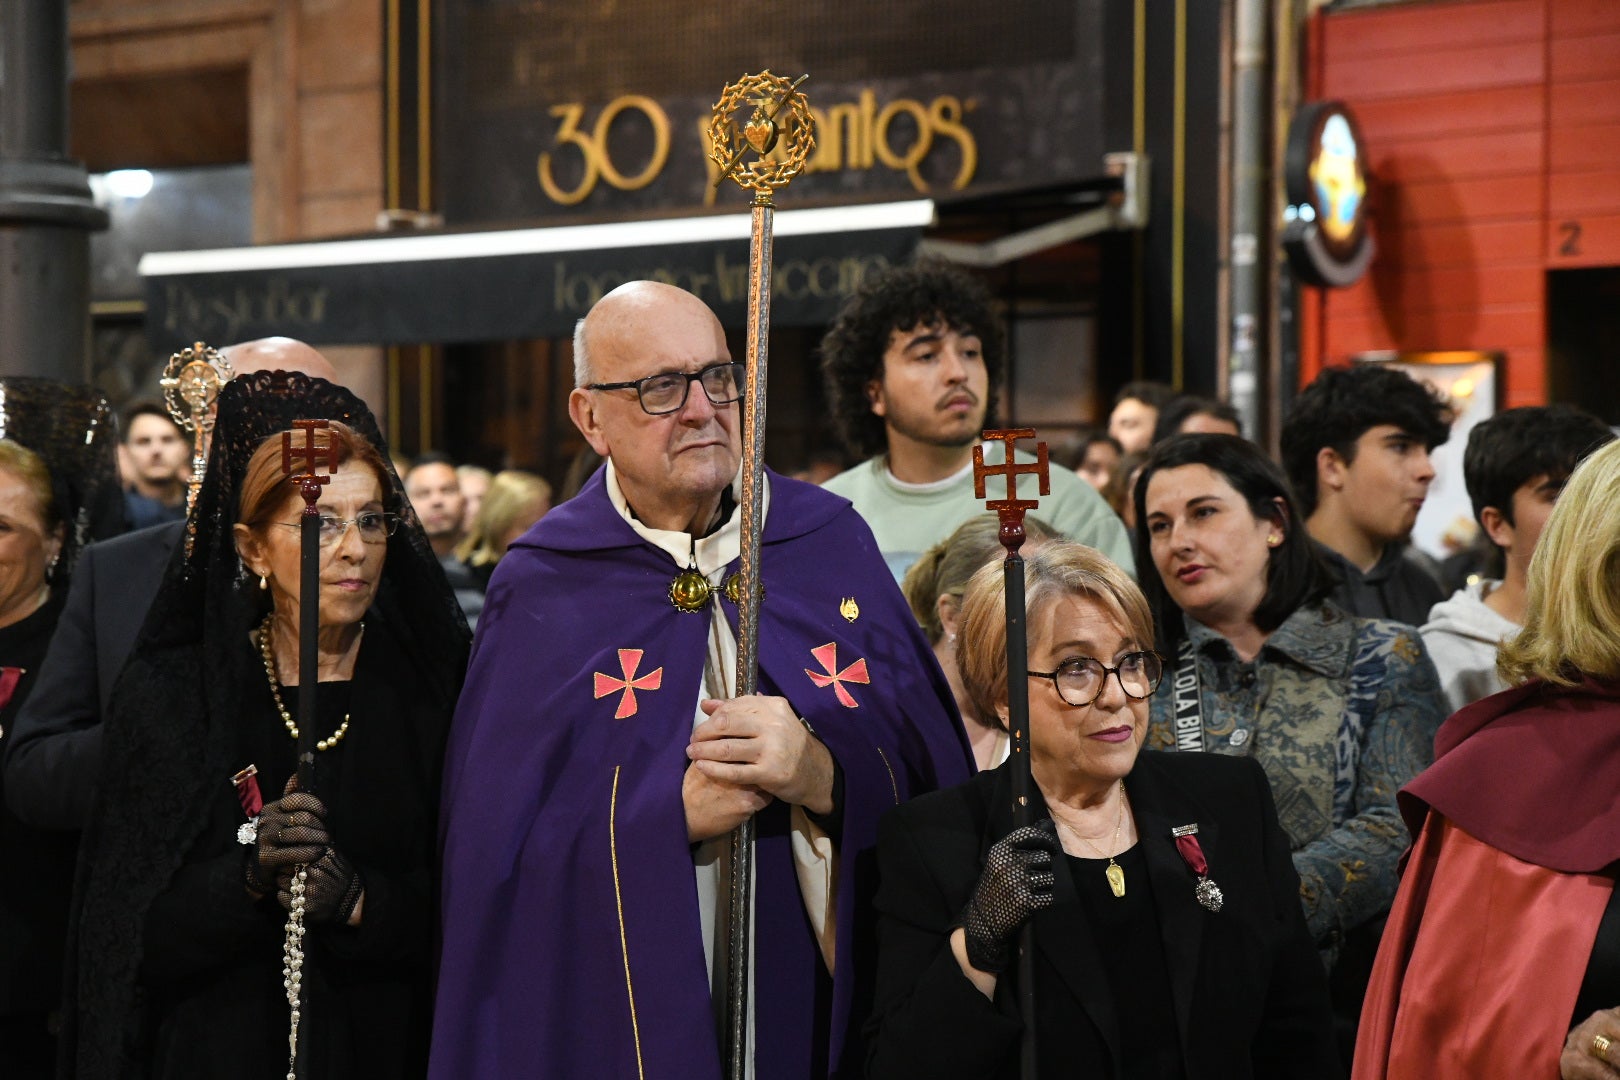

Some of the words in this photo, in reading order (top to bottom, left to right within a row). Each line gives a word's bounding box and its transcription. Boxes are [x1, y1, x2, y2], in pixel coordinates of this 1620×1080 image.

[537, 95, 671, 205] 30
[1559, 221, 1582, 256] 2
[1175, 665, 1199, 713] LOLA
[1176, 715, 1203, 752] BIM
